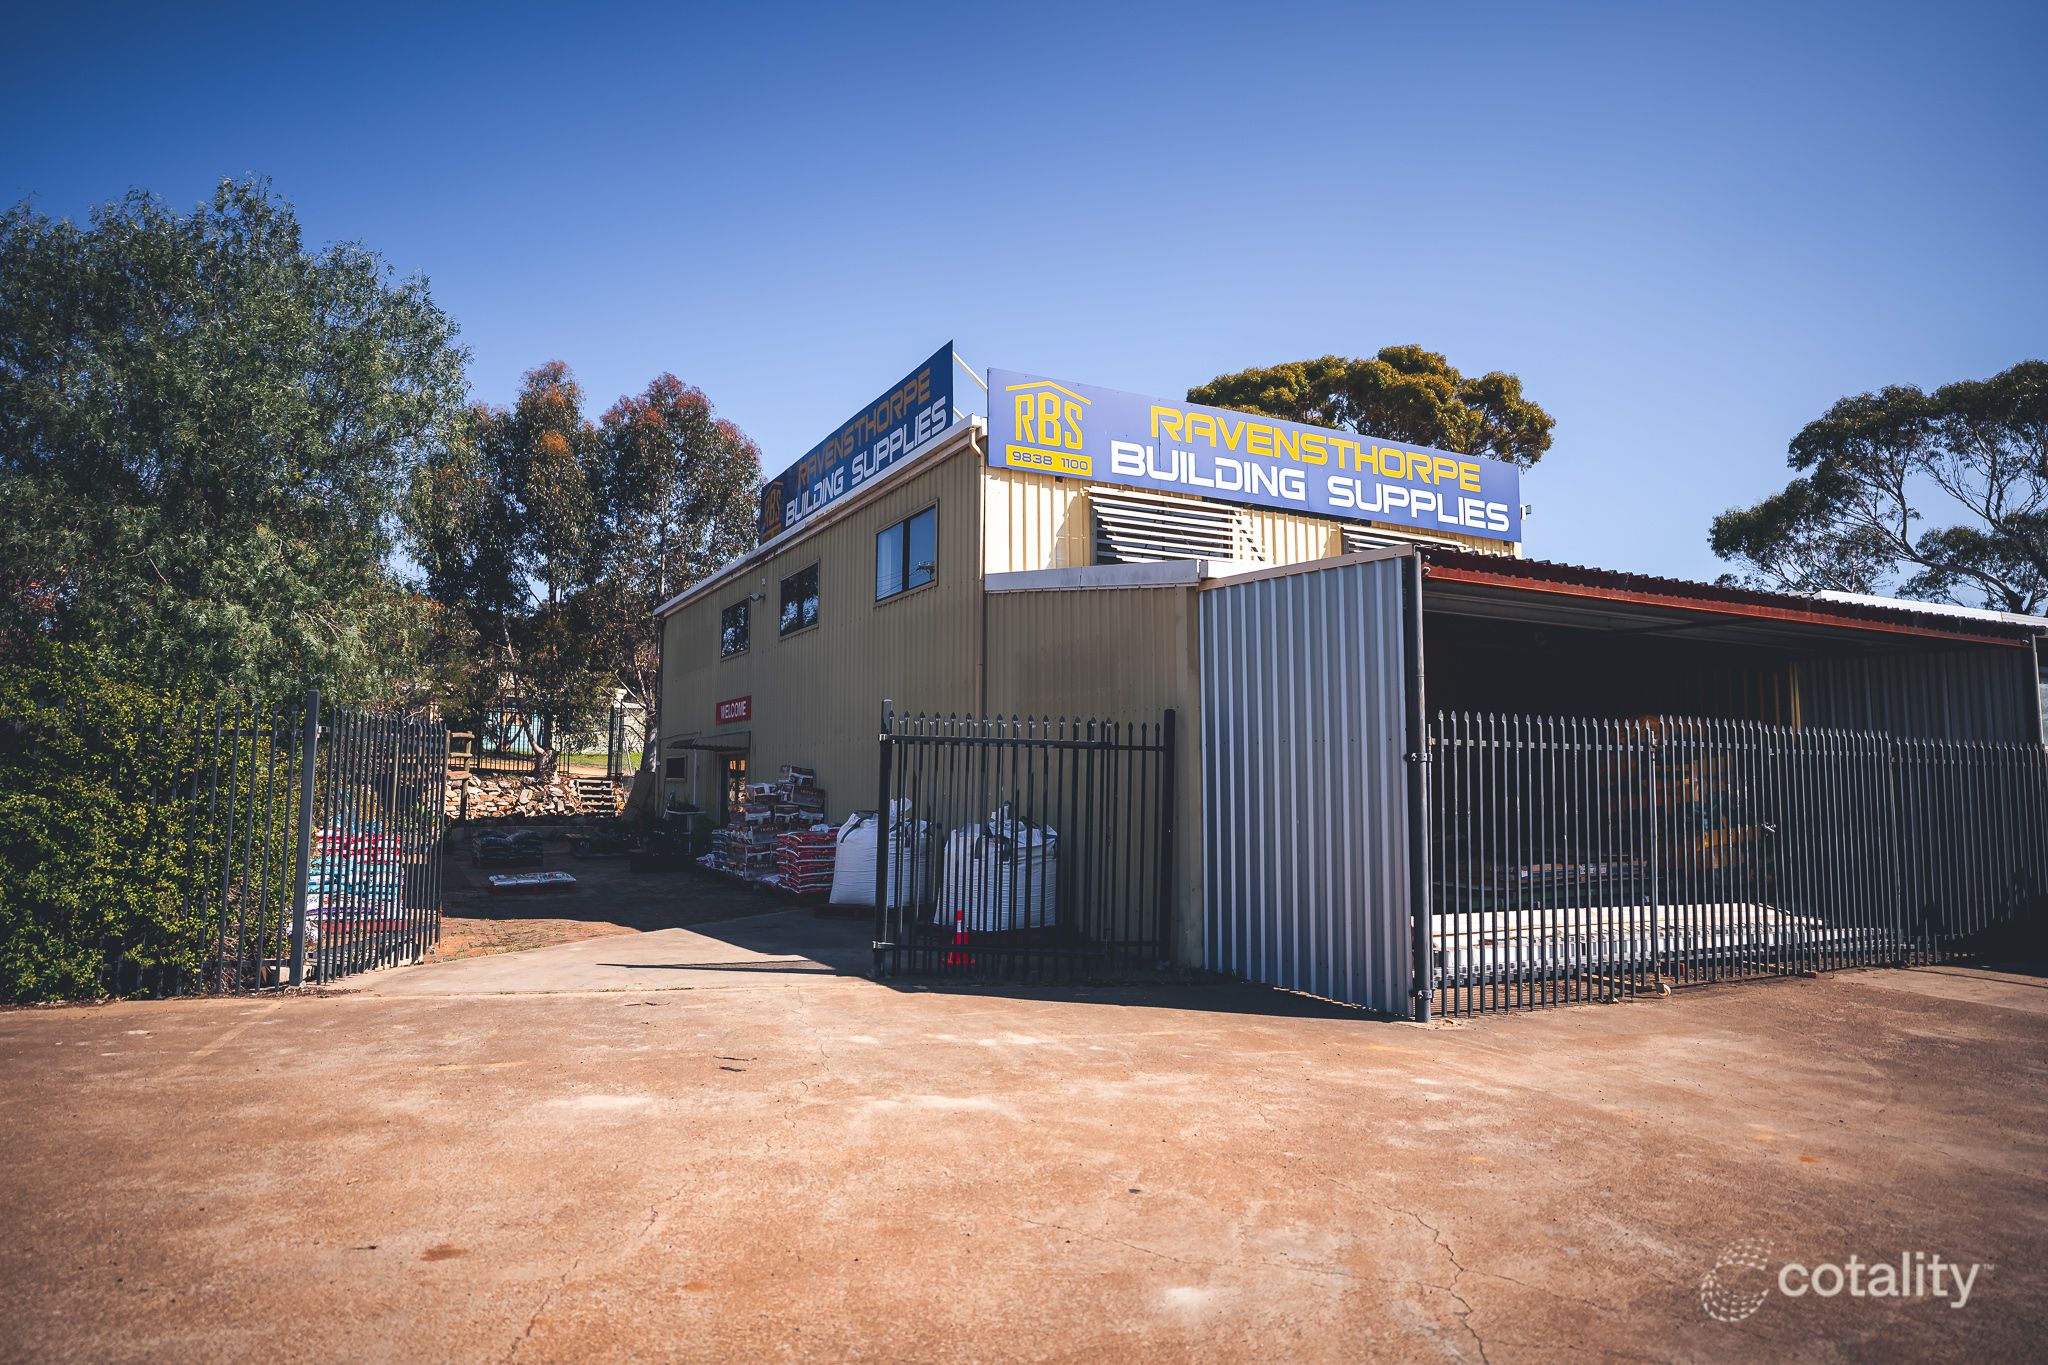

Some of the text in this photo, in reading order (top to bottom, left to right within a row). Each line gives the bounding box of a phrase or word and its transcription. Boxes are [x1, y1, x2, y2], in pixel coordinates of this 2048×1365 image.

[785, 396, 946, 527] BUILDING SUPPLIES
[797, 368, 931, 488] RAVENSTHORPE
[1012, 451, 1088, 470] 9838 1100
[1015, 391, 1083, 450] RBS
[1151, 405, 1481, 493] RAVENSTHORPE
[1111, 440, 1510, 532] BUILDING SUPPLIES
[720, 700, 746, 720] WELCOME
